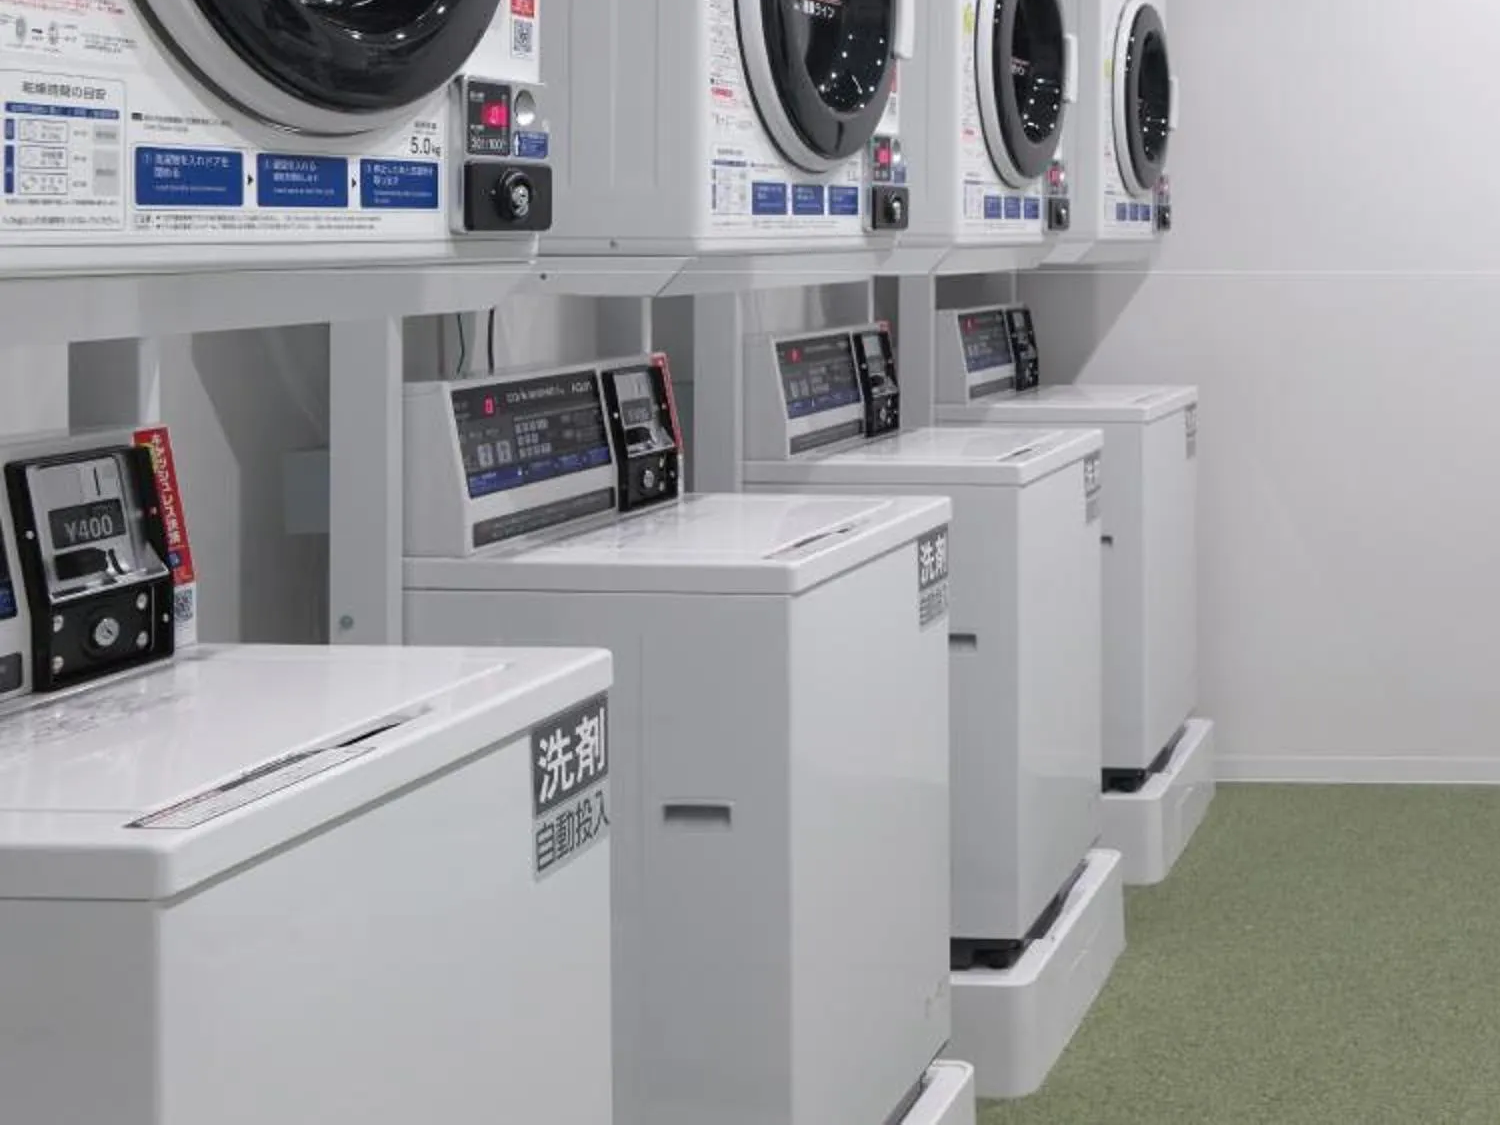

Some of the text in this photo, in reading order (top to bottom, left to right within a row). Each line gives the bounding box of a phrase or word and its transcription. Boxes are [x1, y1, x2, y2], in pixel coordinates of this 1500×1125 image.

[538, 706, 605, 804] 洗剤
[535, 789, 611, 874] 自動投入
